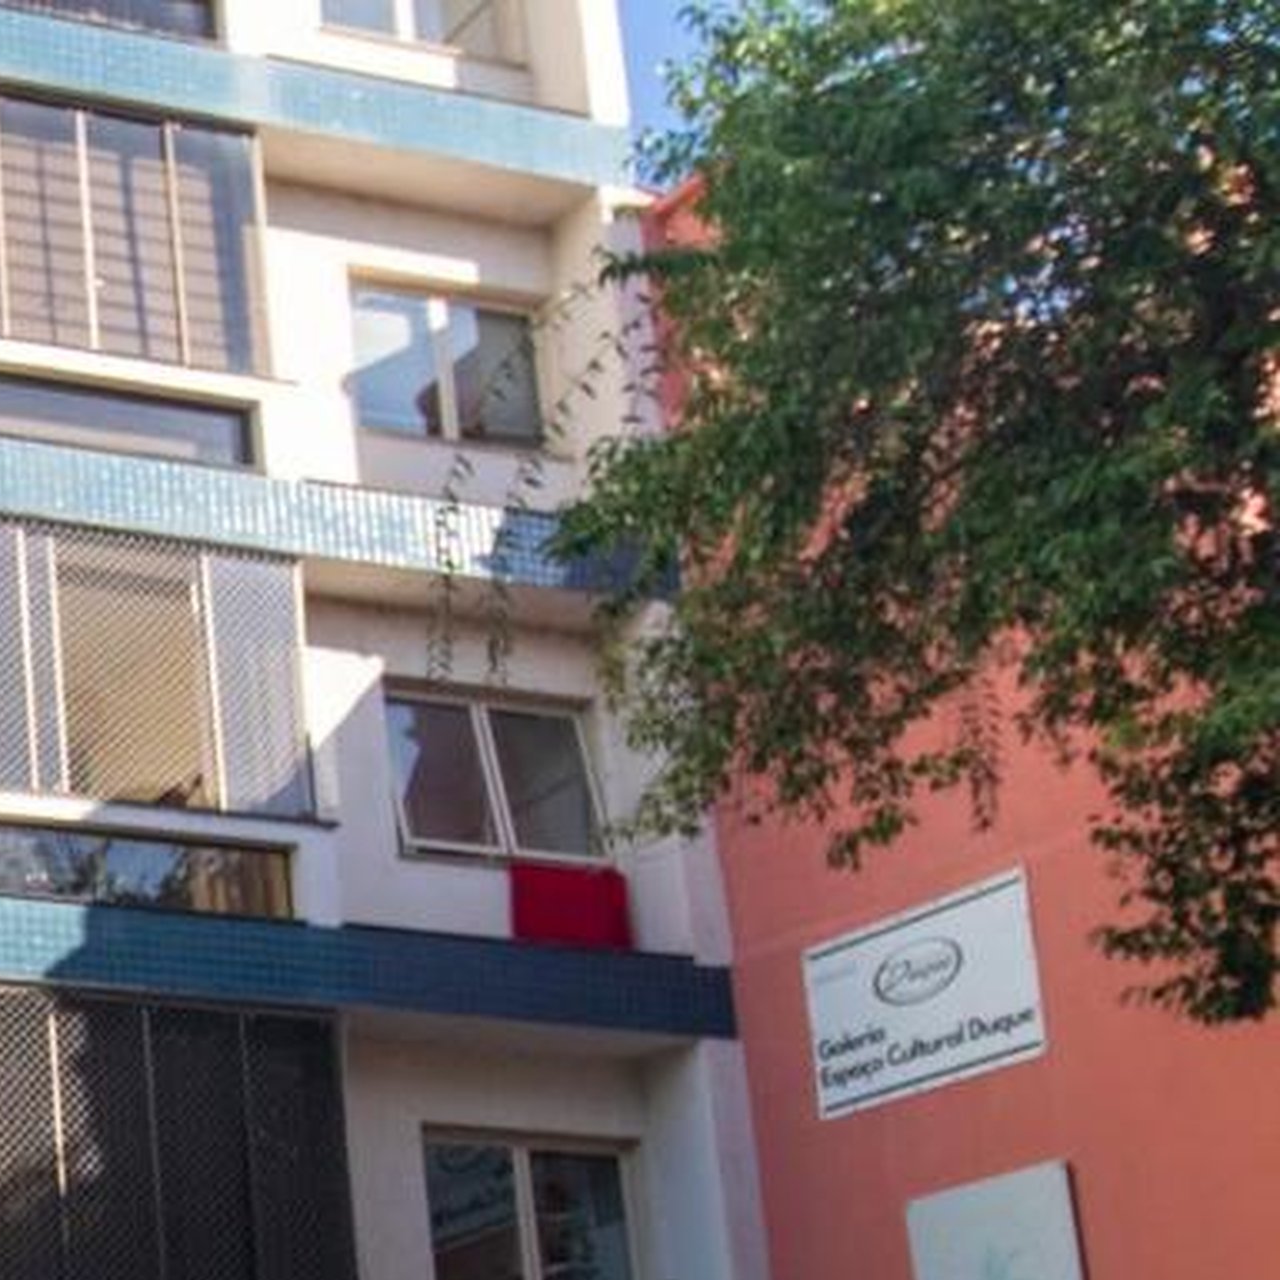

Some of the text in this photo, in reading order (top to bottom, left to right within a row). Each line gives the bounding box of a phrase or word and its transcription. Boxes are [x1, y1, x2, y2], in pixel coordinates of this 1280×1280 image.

[818, 1024, 886, 1062] Galeria
[887, 1020, 965, 1067] Cultural
[968, 1007, 1035, 1042] Duque
